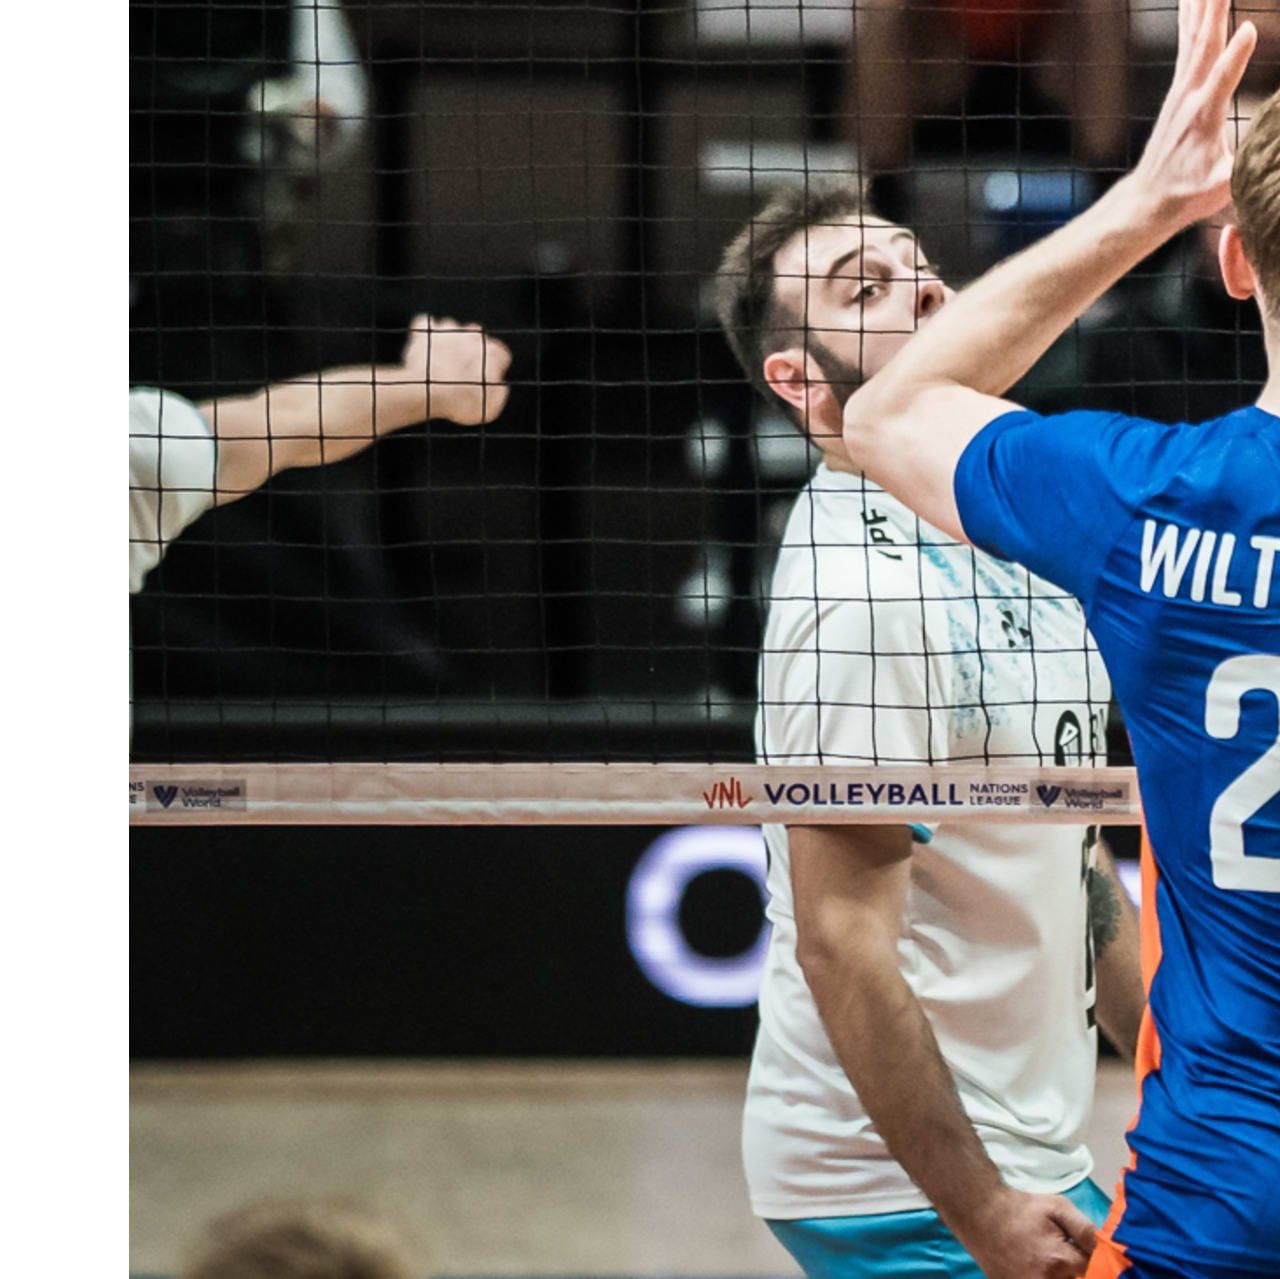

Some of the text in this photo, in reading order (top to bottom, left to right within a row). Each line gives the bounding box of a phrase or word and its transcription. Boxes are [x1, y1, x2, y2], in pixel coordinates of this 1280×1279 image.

[702, 776, 1029, 809] VNL VOLLEYBALL NATIONS
[969, 795, 1021, 806] LEAGUE
